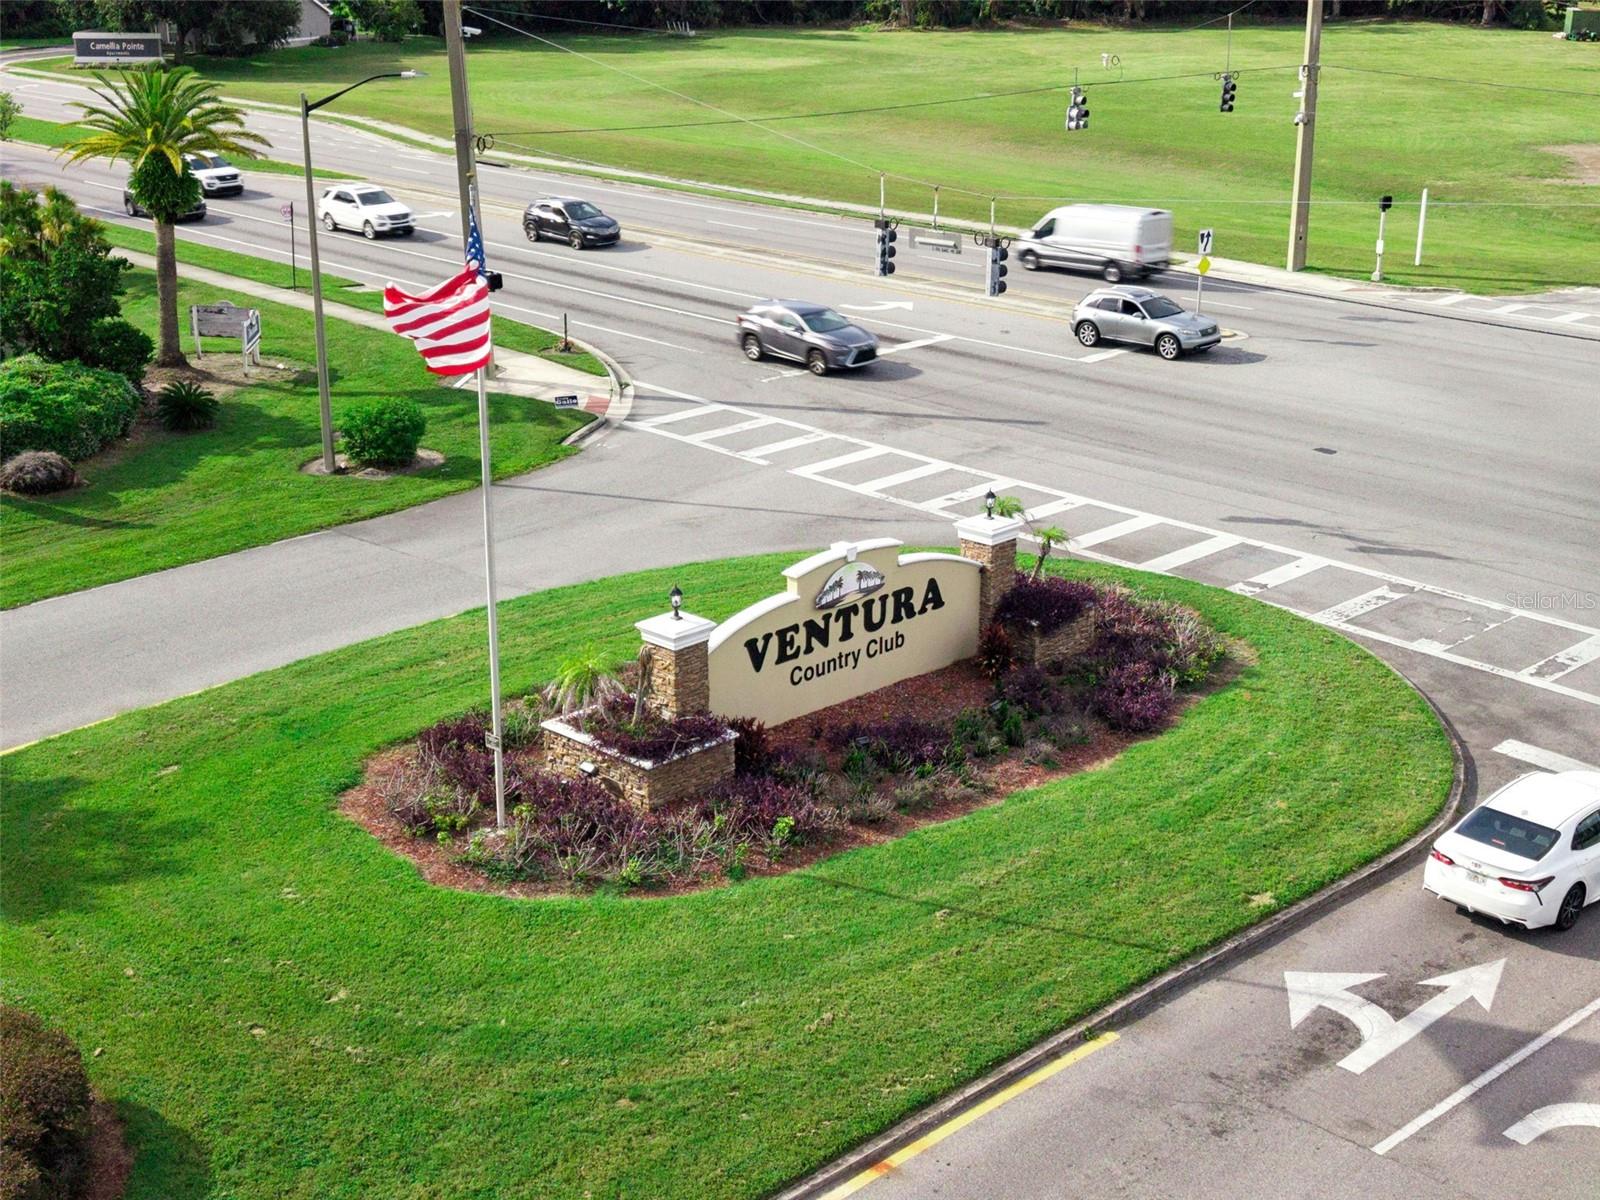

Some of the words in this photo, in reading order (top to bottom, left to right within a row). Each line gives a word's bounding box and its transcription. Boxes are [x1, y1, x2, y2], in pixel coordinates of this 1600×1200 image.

[90, 41, 120, 50] Camellia
[122, 41, 144, 50] Pointe
[744, 577, 945, 673] VENTURA
[790, 648, 861, 686] Country
[866, 631, 905, 658] Club
